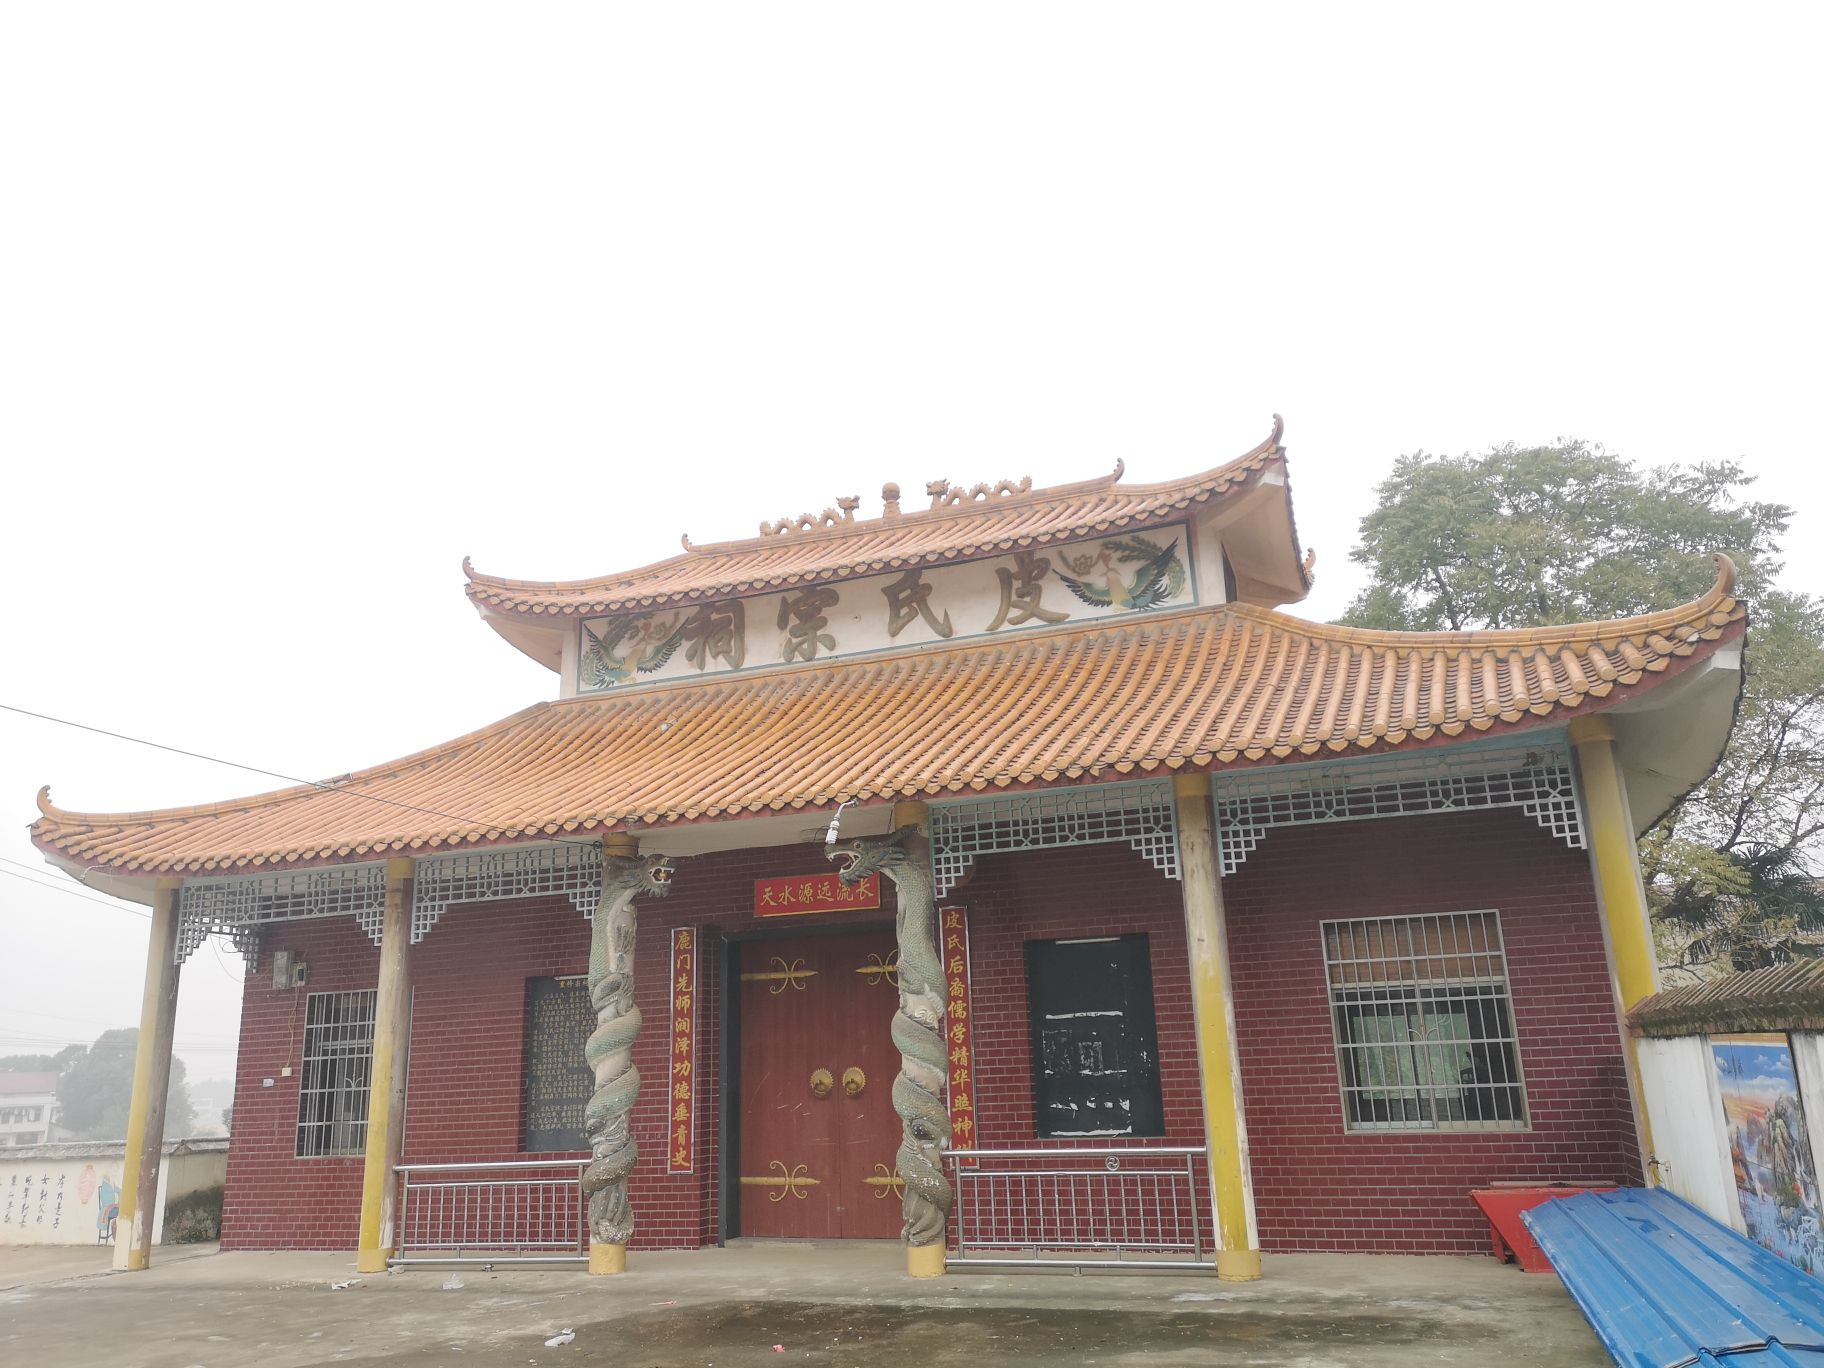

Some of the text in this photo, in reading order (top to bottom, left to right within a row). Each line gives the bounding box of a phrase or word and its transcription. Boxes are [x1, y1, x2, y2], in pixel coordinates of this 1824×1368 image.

[760, 879, 875, 905] 天水源远流长
[672, 933, 692, 1166] 鹿门先师润泽功德垂青史
